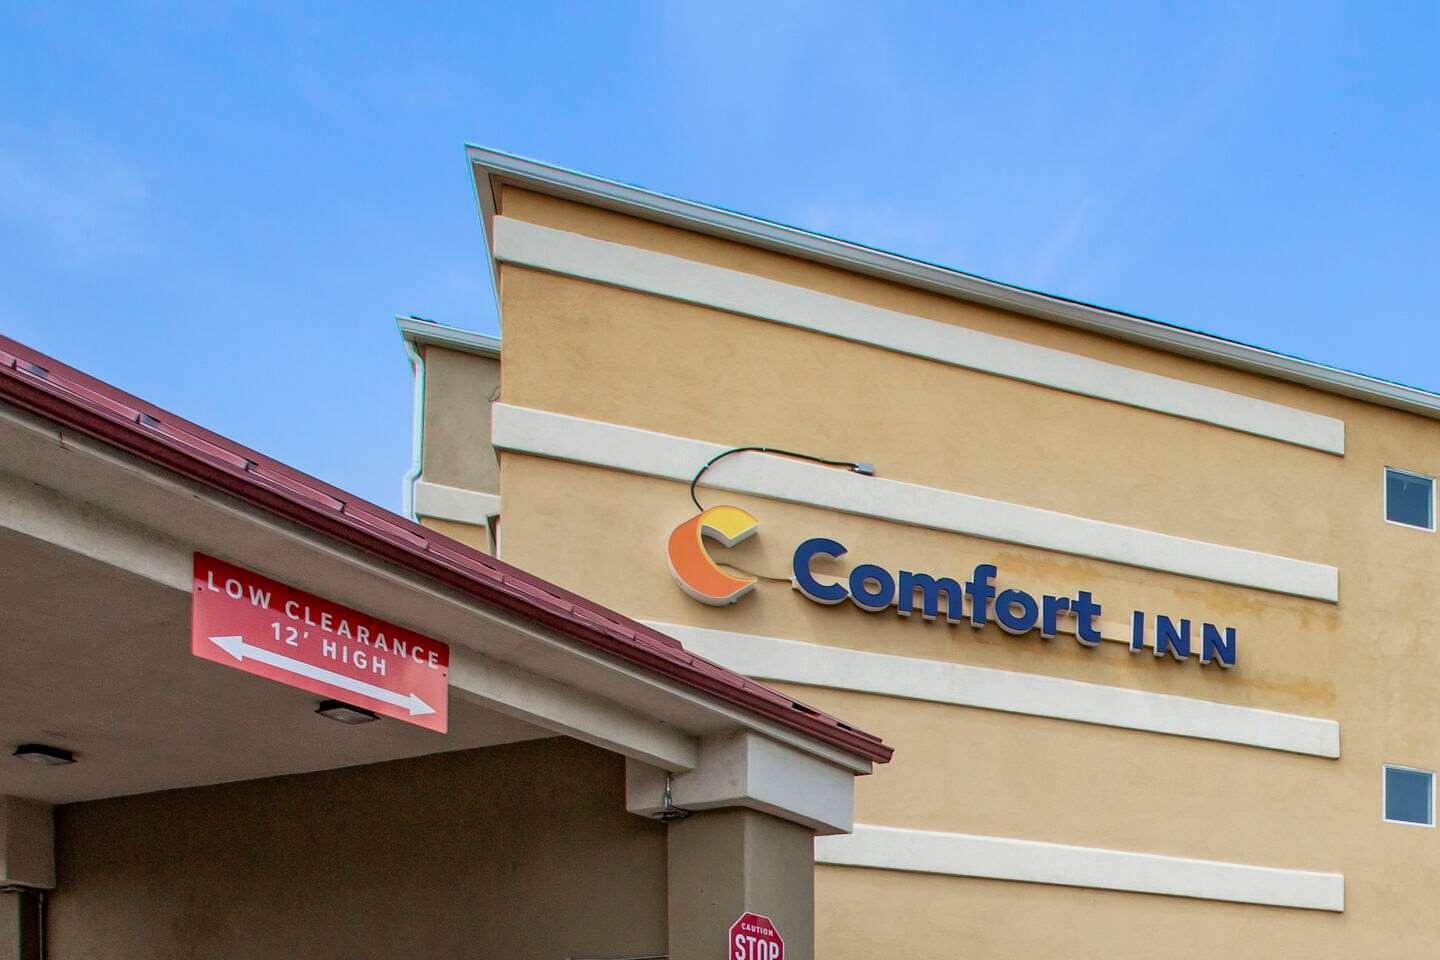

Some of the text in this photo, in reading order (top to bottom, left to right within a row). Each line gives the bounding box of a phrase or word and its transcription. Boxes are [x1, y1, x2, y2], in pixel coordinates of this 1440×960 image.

[207, 570, 439, 670] LOW CLEARANCE
[792, 537, 1237, 669] Comfort INN
[271, 622, 386, 676] 12' HIGH
[741, 922, 774, 937] CAUTION
